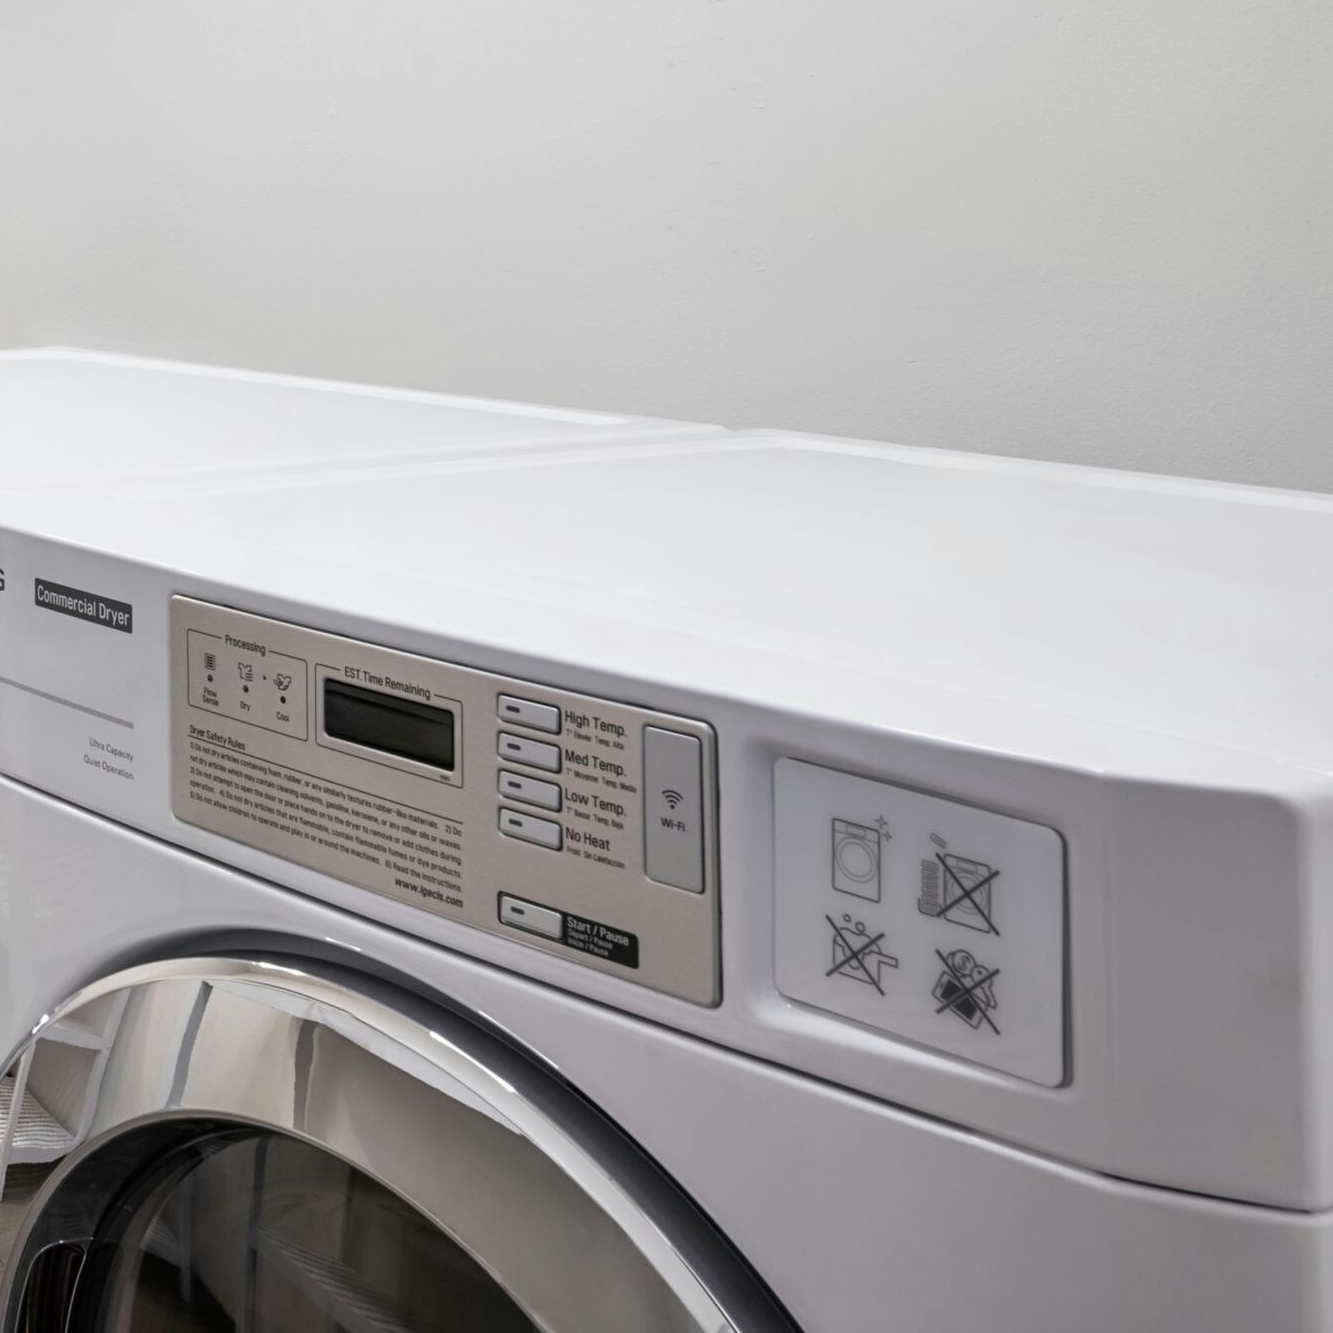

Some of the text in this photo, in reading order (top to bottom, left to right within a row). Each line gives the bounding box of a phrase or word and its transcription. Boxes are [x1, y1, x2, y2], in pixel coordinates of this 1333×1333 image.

[38, 585, 129, 626] Commercial Dryer
[225, 634, 266, 656] Processing
[203, 688, 217, 699] Flow
[385, 677, 430, 700] Remaining
[203, 695, 219, 707] Sense
[240, 701, 250, 711] Dry
[277, 712, 289, 723] Cool
[565, 710, 627, 737] High Temp.
[89, 738, 133, 762] Ultra Capacity
[189, 725, 245, 751] Dryer Safety Rules
[84, 754, 134, 780] Quiet Operation
[565, 749, 626, 776] Med Temp.
[565, 788, 626, 816] Low Temp.
[661, 817, 686, 832] Wi-Fi
[566, 827, 610, 851] No Heat
[567, 917, 629, 946] Start / Pause
